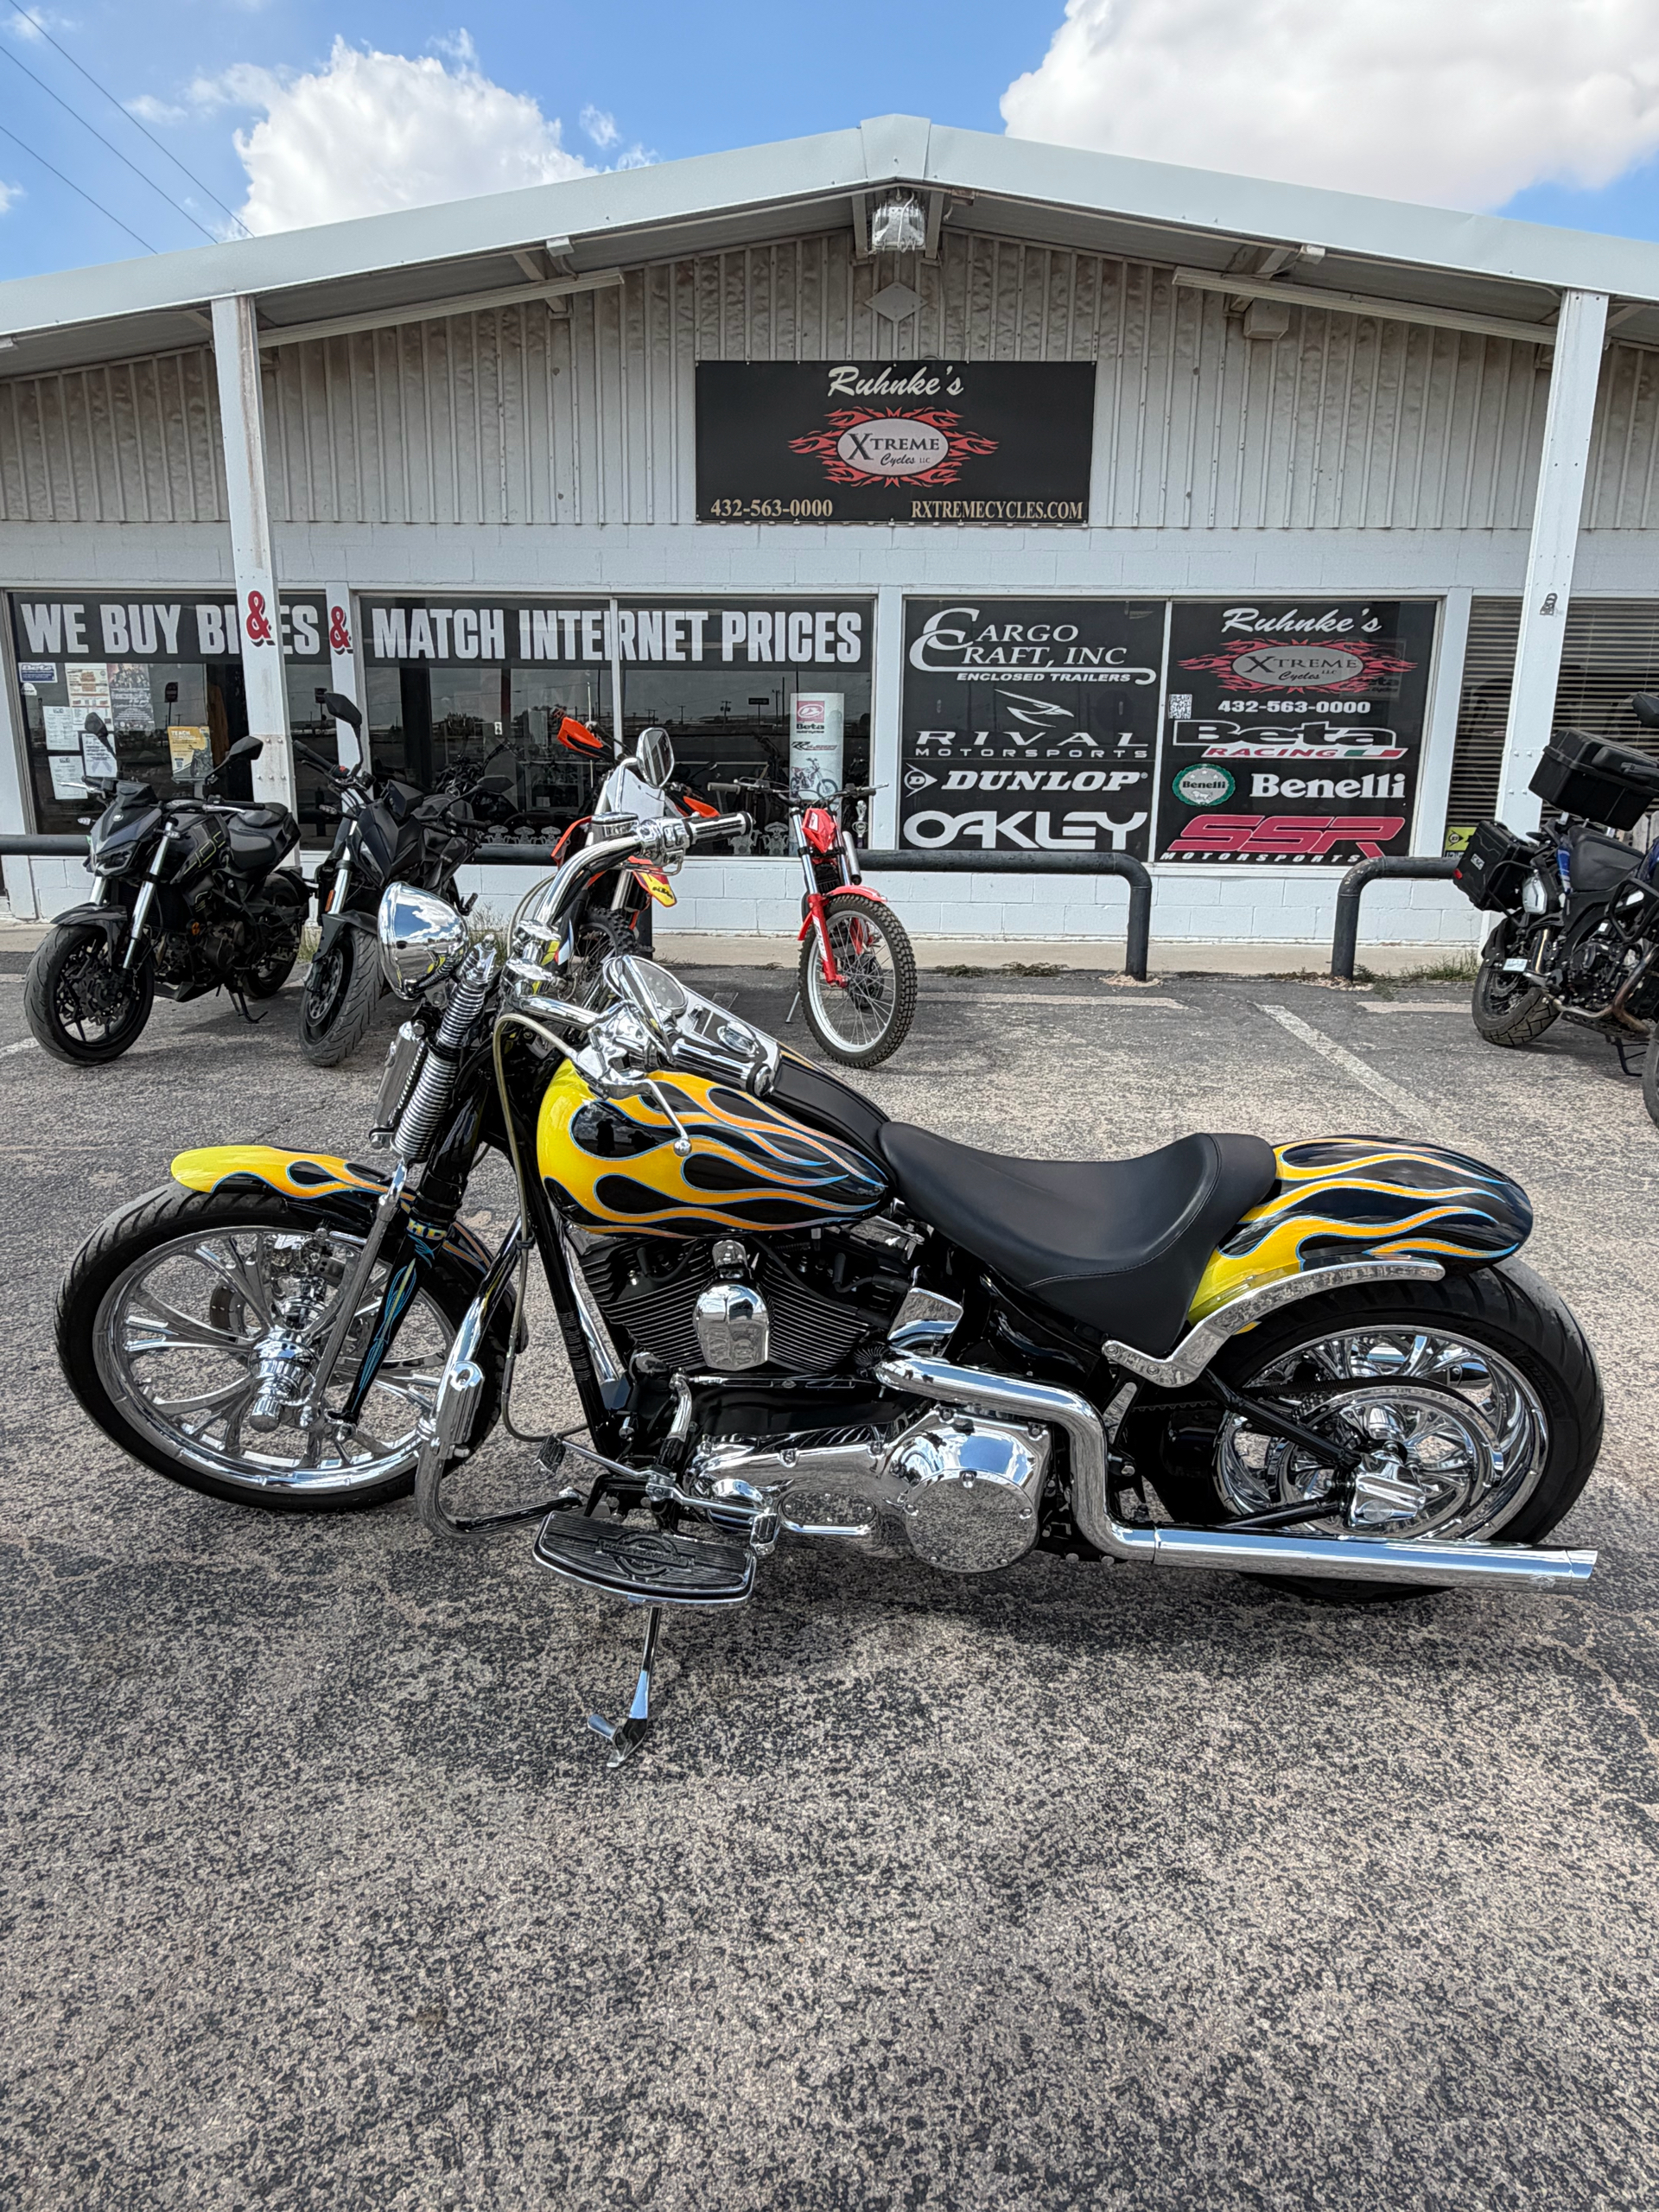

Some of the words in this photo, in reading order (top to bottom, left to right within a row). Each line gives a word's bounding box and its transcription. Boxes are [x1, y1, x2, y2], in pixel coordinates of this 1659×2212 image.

[828, 365, 964, 397] Ruhnke's
[847, 433, 939, 461] XTREME
[880, 452, 916, 467] Cycles
[710, 499, 833, 518] 432-563-0000
[911, 500, 1084, 519] RXTREMECYCLES.COM
[246, 590, 275, 645] &
[1221, 607, 1382, 632] Ruhnke's
[21, 604, 89, 654] WE
[101, 604, 181, 654] BUY
[195, 605, 321, 655] BIES
[330, 606, 353, 654] &
[372, 608, 505, 659] MATCH
[519, 610, 709, 663] INTERNET
[721, 611, 862, 664] PRICES
[1063, 647, 1127, 664] INC
[1243, 656, 1358, 673] XTREME
[957, 673, 1045, 682] ENCLOSED
[1050, 673, 1130, 683] TRAILERS
[1279, 671, 1319, 681] Cycles
[1217, 701, 1371, 713] 432-563-0000
[916, 731, 1148, 747] RIVAL
[1173, 720, 1396, 747] Beta
[916, 748, 1147, 758] MOTORSPORTS
[1209, 748, 1340, 758] RACING
[941, 771, 1141, 791] DUNLOP
[1182, 780, 1226, 789] Benelli
[1249, 773, 1406, 798] Benelli
[903, 810, 1147, 850] OAKLEY
[1167, 814, 1406, 860] SSR
[1160, 852, 1361, 862] MOTORSPORTS
[406, 1217, 447, 1241] HD
